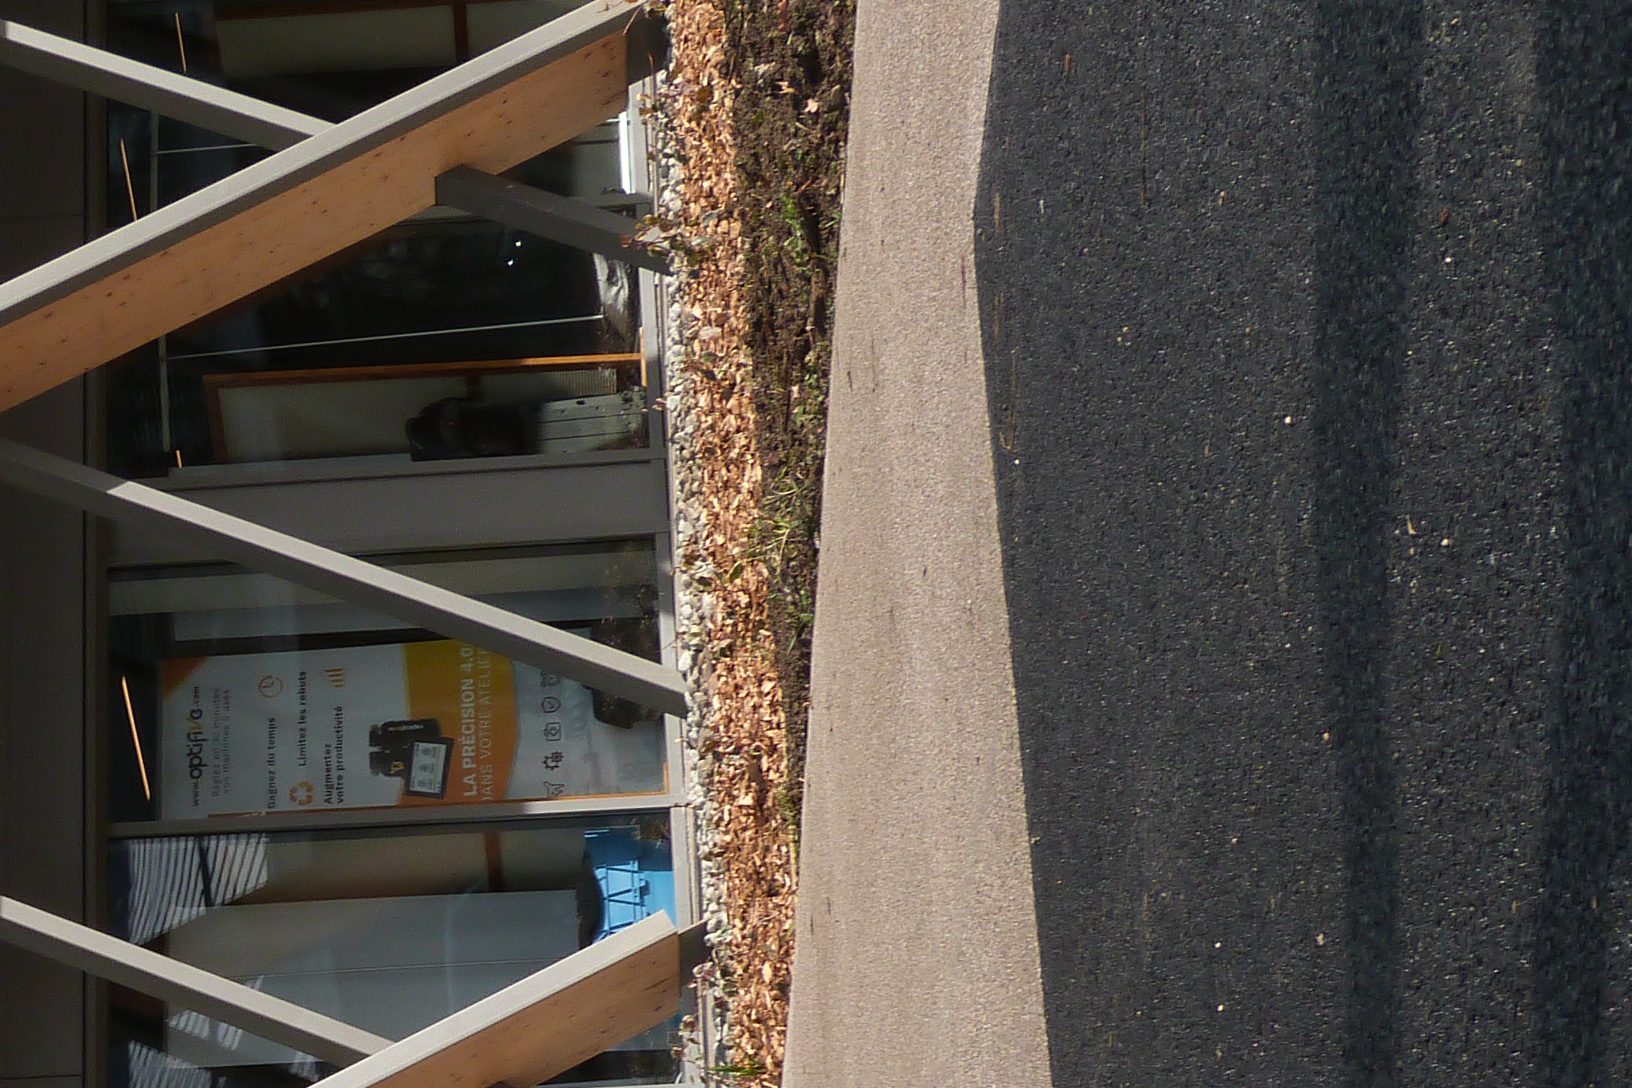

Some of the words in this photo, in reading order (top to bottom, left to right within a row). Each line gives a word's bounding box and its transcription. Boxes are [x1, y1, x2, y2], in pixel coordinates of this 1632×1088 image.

[296, 671, 308, 706] rebuts
[266, 718, 278, 750] temps
[296, 708, 308, 724] les
[458, 678, 477, 768] PRÉCISION
[478, 709, 492, 760] VOTRE
[296, 727, 308, 766] Limitez
[332, 706, 346, 771] productivité
[265, 752, 276, 766] du
[322, 743, 335, 804] Augmentez
[266, 770, 278, 809] Gagnez
[334, 774, 344, 804] votre
[462, 774, 478, 796] LA
